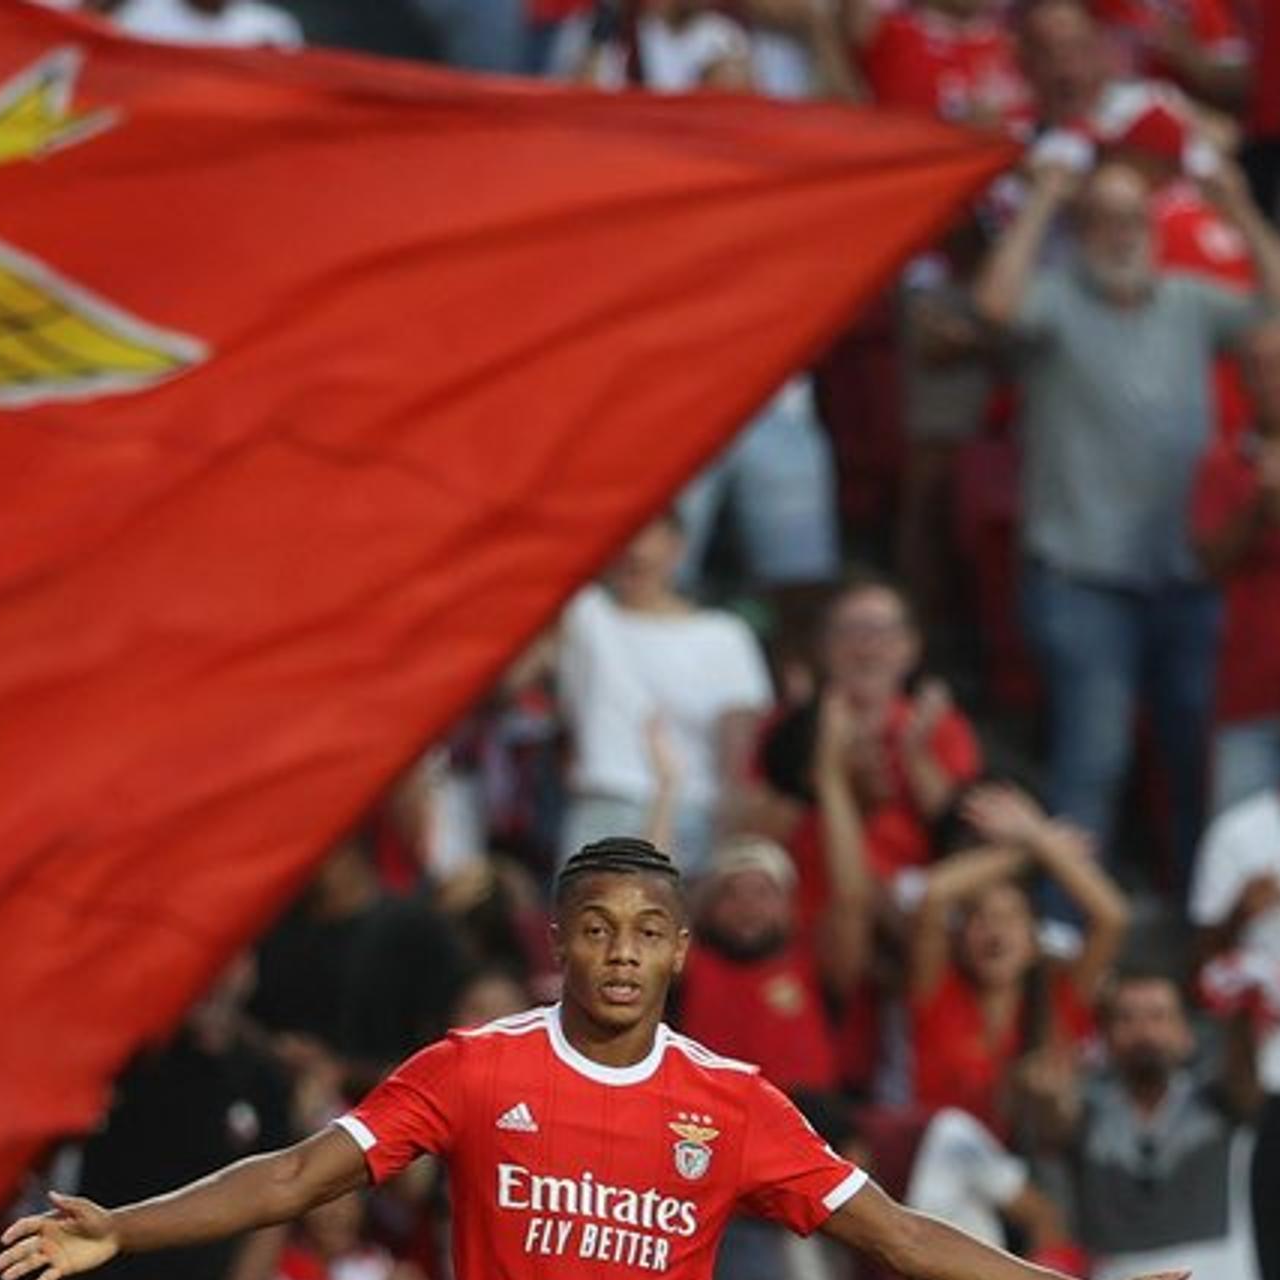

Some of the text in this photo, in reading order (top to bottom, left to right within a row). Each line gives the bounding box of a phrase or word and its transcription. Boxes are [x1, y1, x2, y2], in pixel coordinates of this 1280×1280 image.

[497, 1163, 698, 1237] Emirates
[524, 1216, 669, 1272] FLY BETTER
